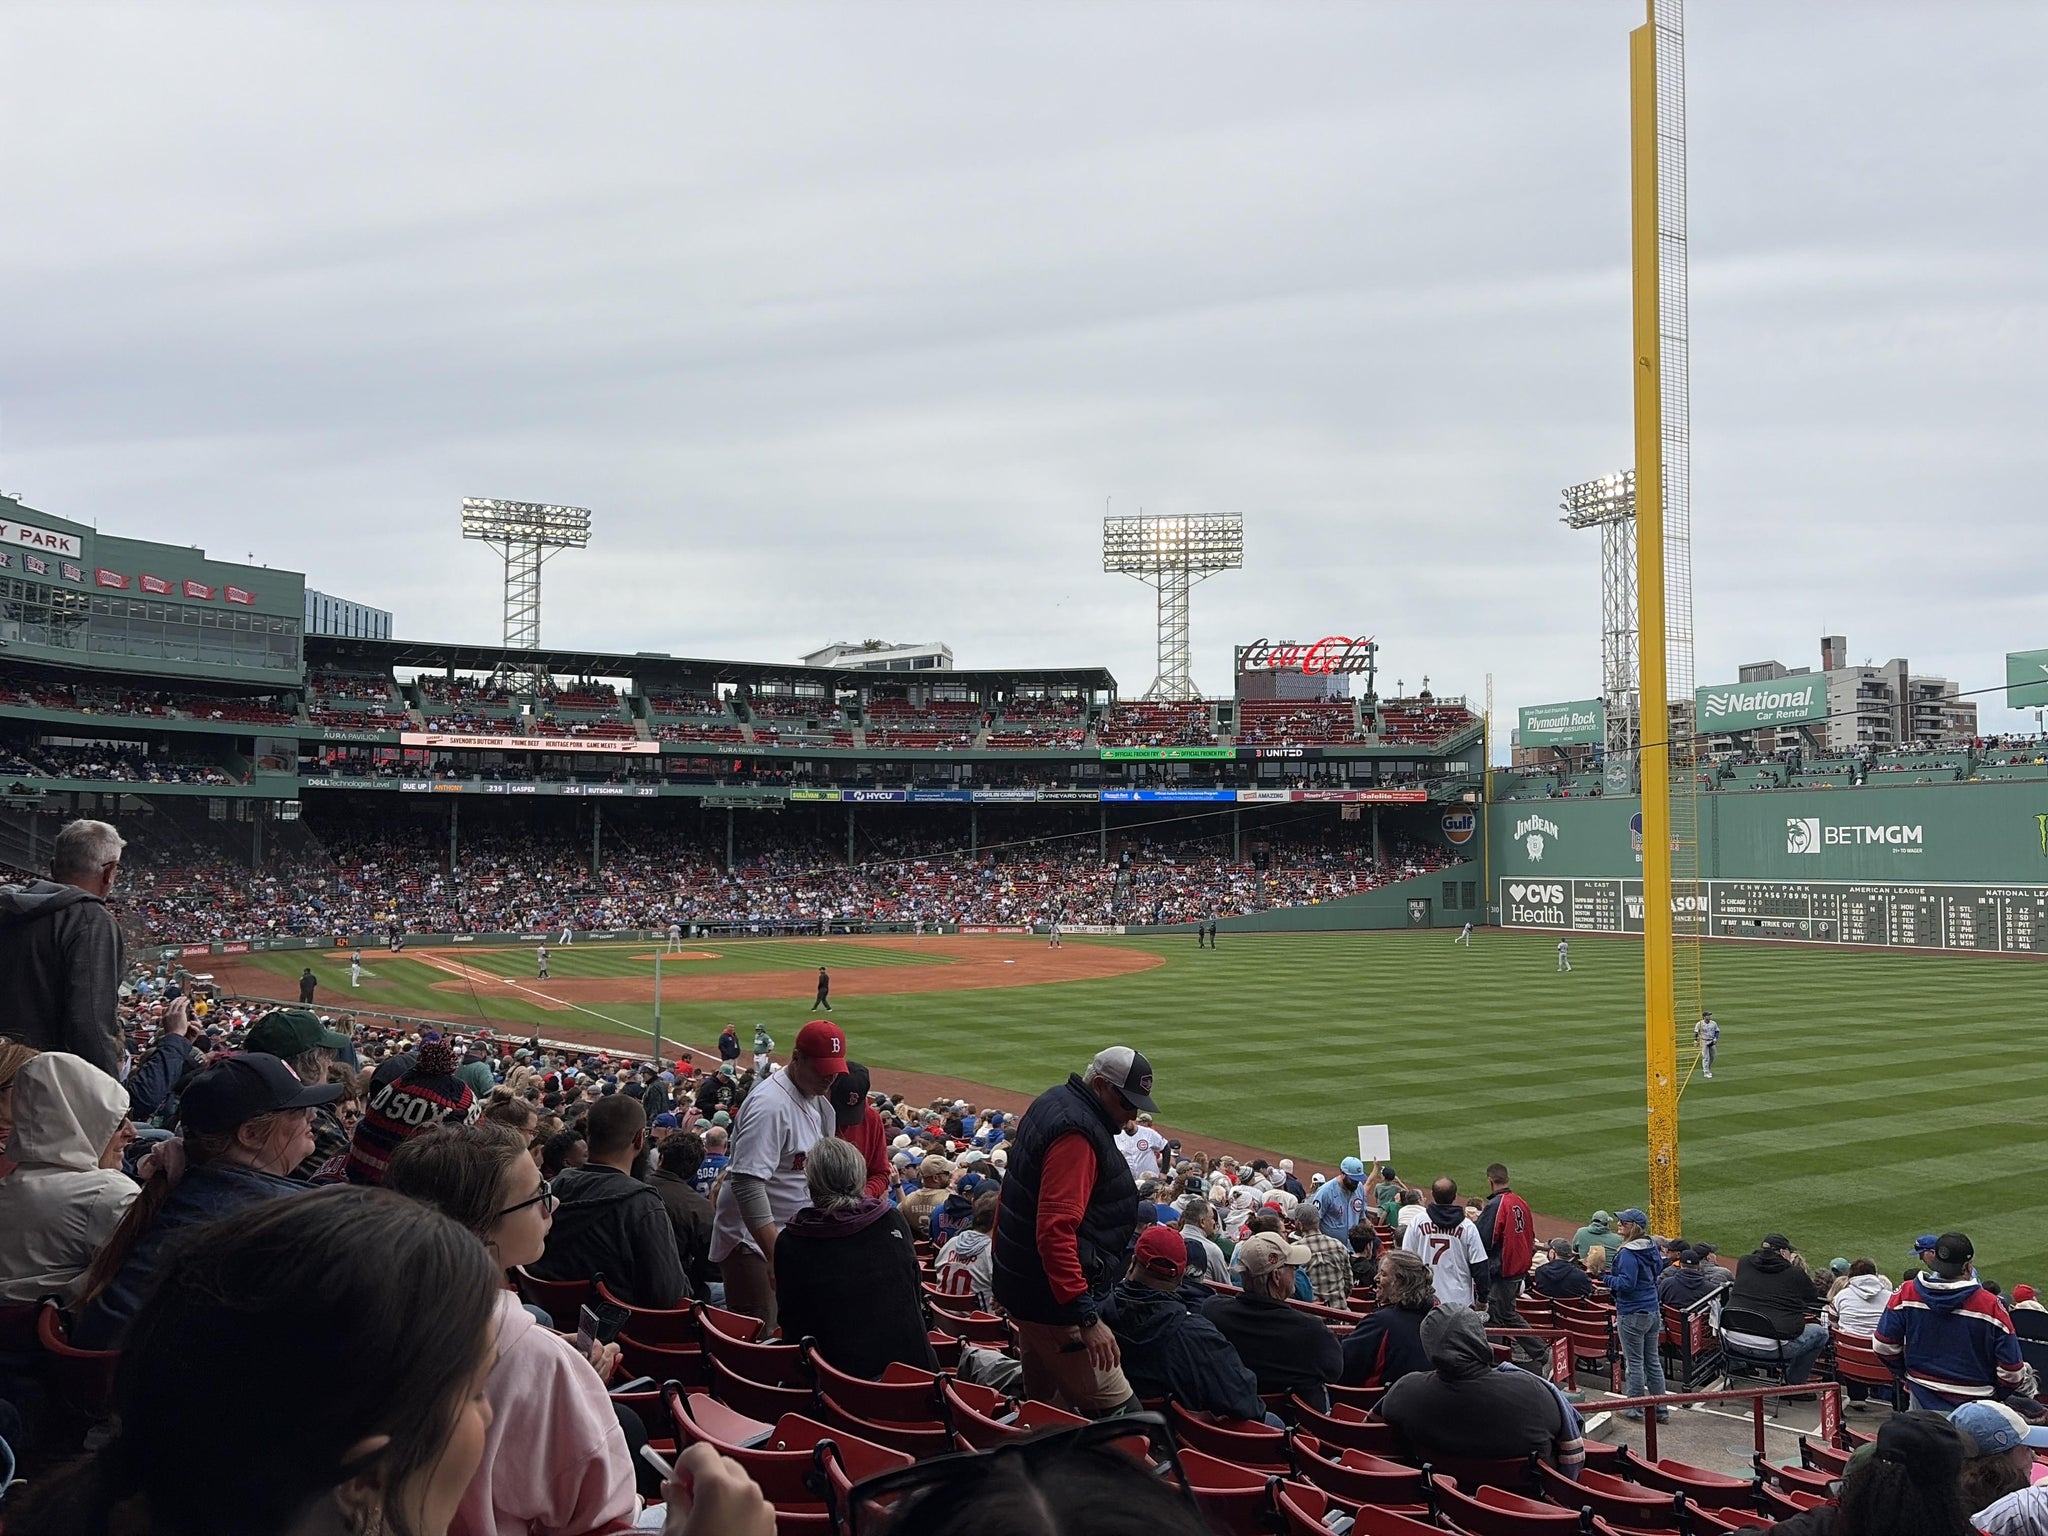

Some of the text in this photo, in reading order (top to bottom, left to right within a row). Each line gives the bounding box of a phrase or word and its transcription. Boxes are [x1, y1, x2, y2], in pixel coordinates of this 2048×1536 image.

[20, 528, 70, 551] PARK
[1239, 635, 1376, 676] Coca-Cola
[1527, 711, 1596, 730] Plymouth Rock
[1756, 708, 1808, 720] Car Rental
[348, 733, 380, 741] PAVILION
[477, 738, 504, 746] BUTCHERY
[511, 739, 527, 747] PRIME
[718, 746, 738, 754] AURA
[1266, 749, 1304, 758] UNITED
[308, 778, 390, 788] DELL Technologies Level
[563, 786, 580, 794] .254
[588, 787, 624, 795] RUTSCHMAN
[792, 790, 819, 799] SULLIVAN
[866, 792, 894, 800] HYCU
[1443, 816, 1474, 830] Gulf
[1514, 814, 1560, 840] JIM BEAM
[1824, 825, 1922, 844] BETMGM
[1526, 884, 1564, 904] CVS
[1512, 904, 1565, 924] Health
[182, 947, 210, 955] Safelite
[224, 945, 248, 953] Safelite
[831, 1037, 841, 1053] B
[848, 1091, 860, 1106] B
[697, 1167, 720, 1180] SOSA
[1418, 1222, 1464, 1240] YOSHIDA
[1429, 1238, 1450, 1265] 7
[937, 1264, 973, 1296] 10
[1693, 1337, 1698, 1346] 5
[1556, 1362, 1567, 1374] 94
[1826, 1414, 1834, 1430] 93
